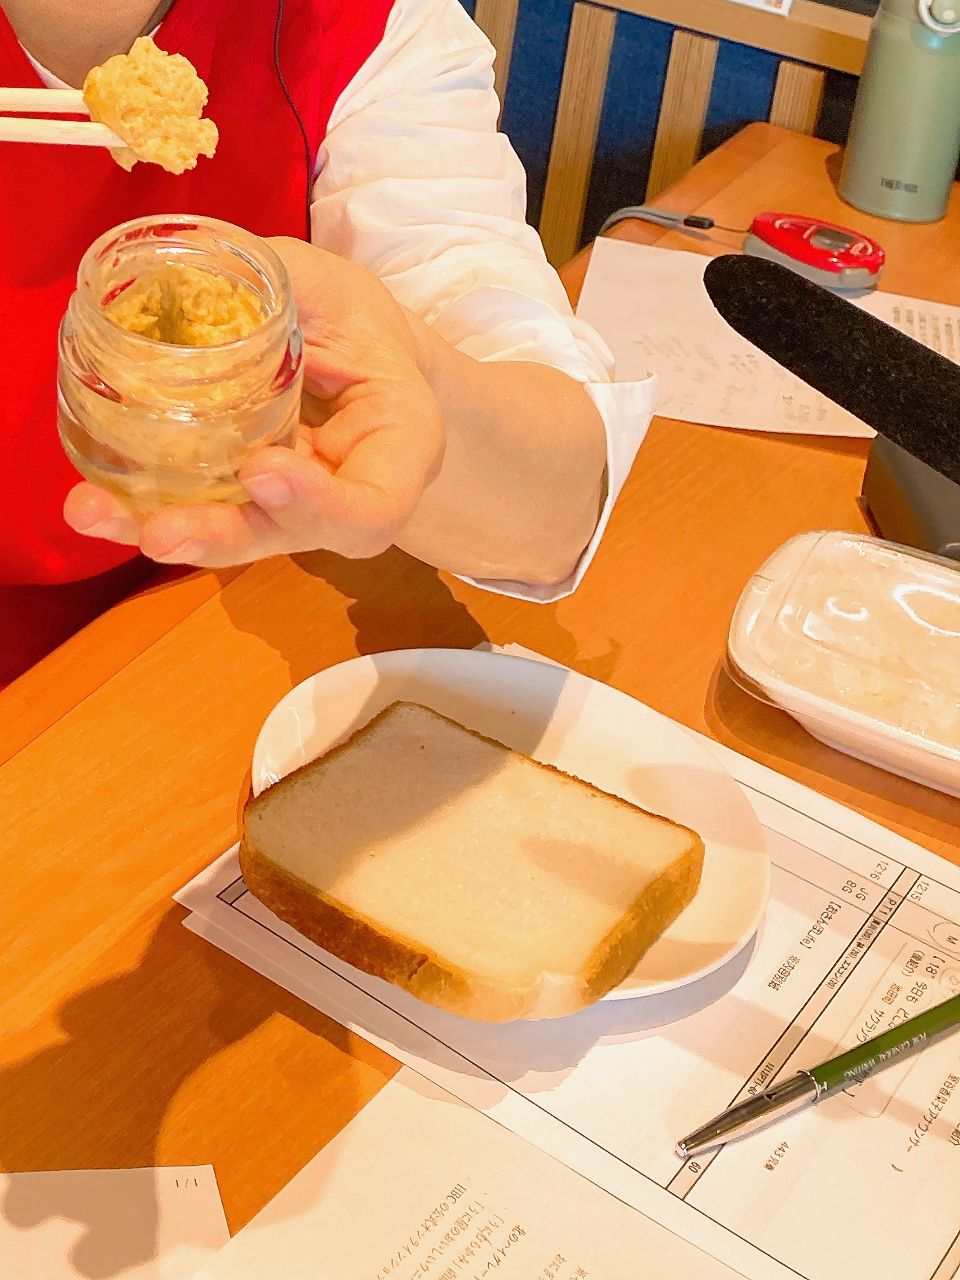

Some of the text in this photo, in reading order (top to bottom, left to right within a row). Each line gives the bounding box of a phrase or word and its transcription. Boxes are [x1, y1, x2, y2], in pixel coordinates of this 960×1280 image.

[869, 860, 890, 881] 1216
[910, 880, 930, 901] 1215
[878, 898, 897, 916] PT1
[905, 981, 928, 1003] 今日も
[688, 1161, 701, 1174] 60
